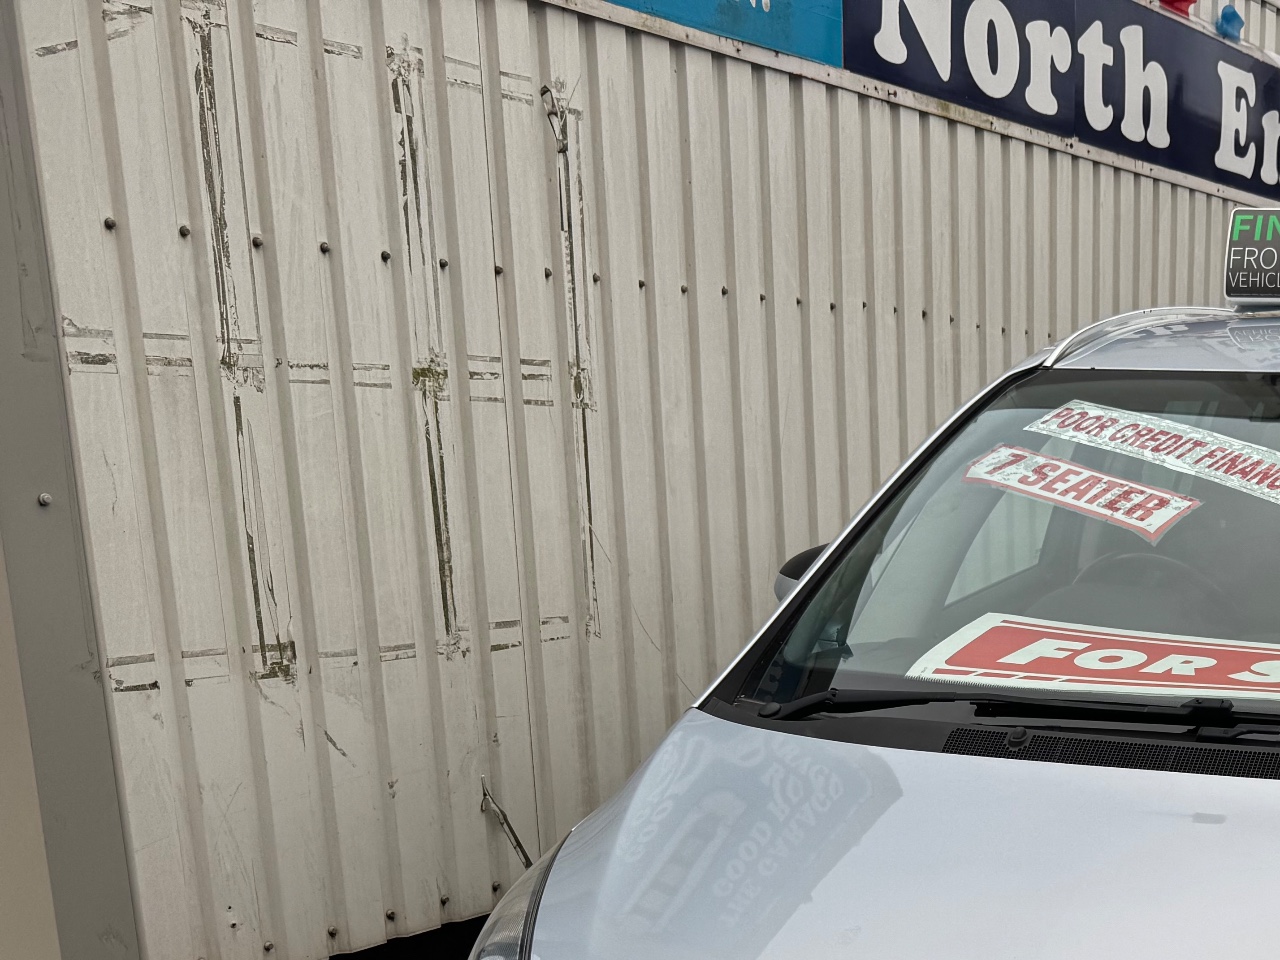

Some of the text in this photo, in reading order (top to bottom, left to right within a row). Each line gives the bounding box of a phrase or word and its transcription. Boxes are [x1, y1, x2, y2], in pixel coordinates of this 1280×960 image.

[872, 0, 1171, 149] North
[1050, 407, 1118, 437] POOR
[1112, 419, 1204, 464] CREDIT
[987, 453, 1170, 523] 7 SEATER
[995, 637, 1219, 677] FOR
